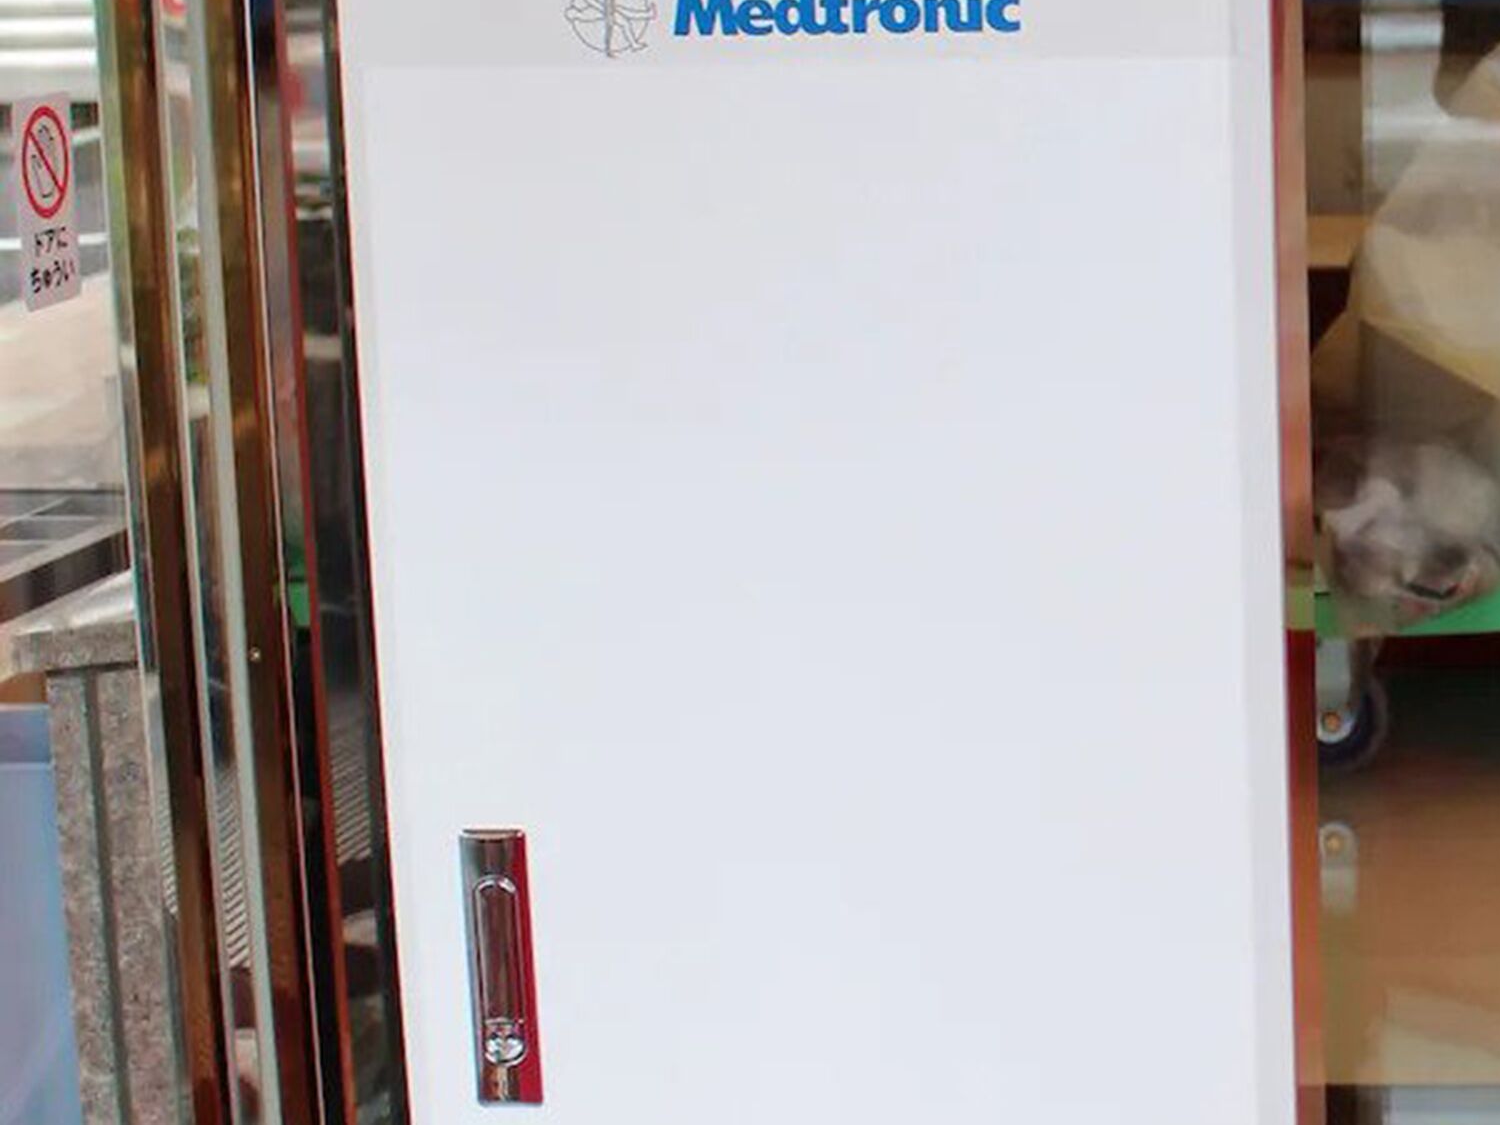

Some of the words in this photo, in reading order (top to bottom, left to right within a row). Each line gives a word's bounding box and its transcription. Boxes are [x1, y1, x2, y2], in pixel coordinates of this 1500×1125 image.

[34, 226, 69, 258] ドアに
[31, 259, 76, 294] ちゅうい
